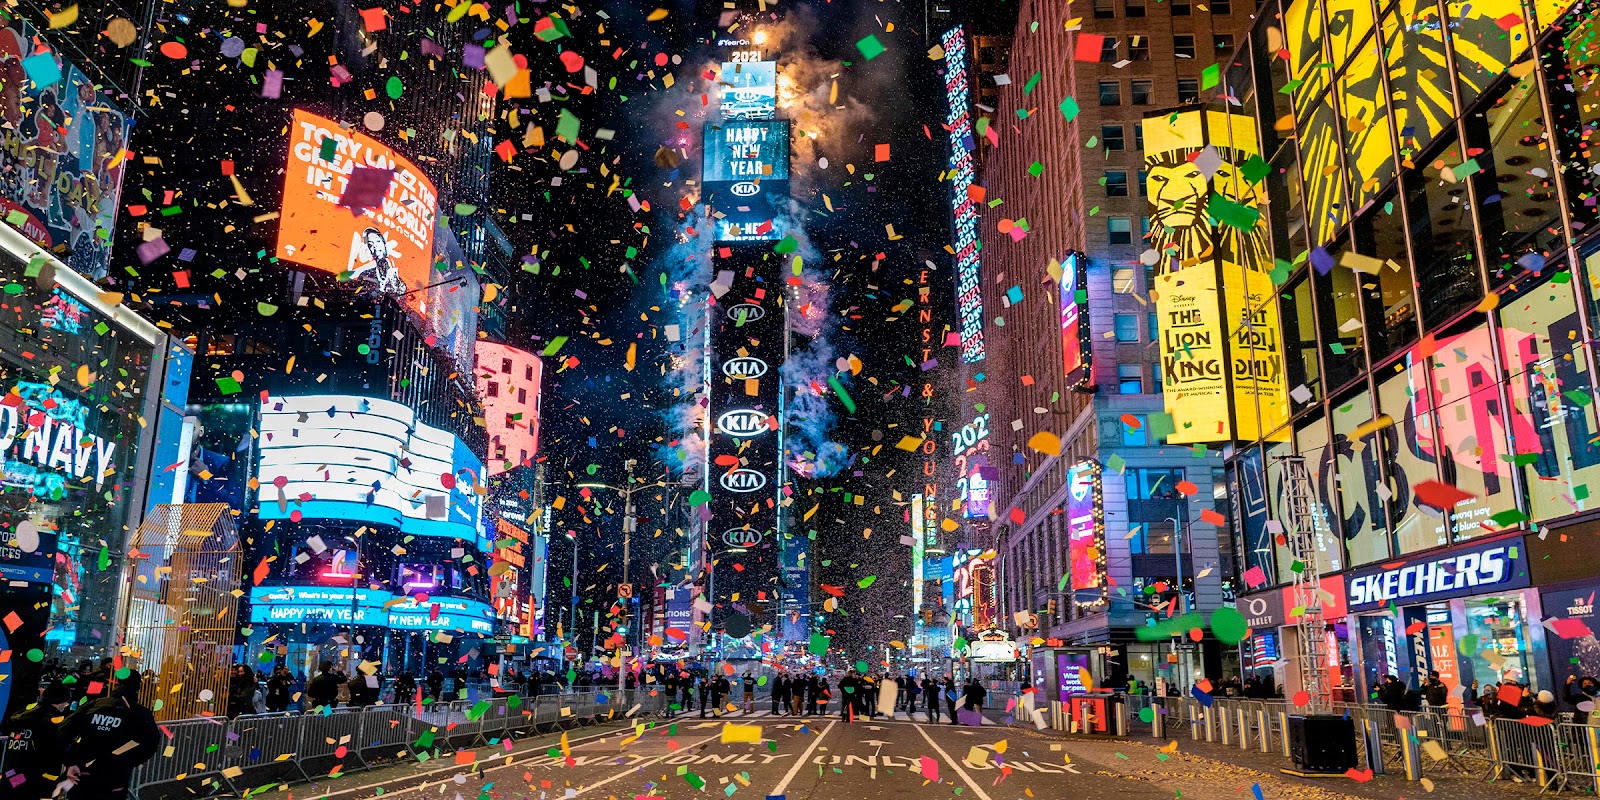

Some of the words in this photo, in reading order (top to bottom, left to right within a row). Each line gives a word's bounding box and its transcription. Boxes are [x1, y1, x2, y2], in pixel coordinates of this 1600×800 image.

[732, 51, 761, 62] 2021
[945, 60, 965, 84] 2021
[946, 69, 967, 92] 2021
[947, 102, 968, 126] 2021
[726, 128, 768, 143] HAPPY
[733, 144, 760, 159] NEW
[4, 129, 100, 214] HOLIDAY
[307, 166, 332, 190] IN
[730, 160, 763, 175] YEAR
[22, 222, 46, 242] AVY
[955, 230, 976, 253] 2021
[957, 239, 977, 262] 2021
[958, 274, 979, 297] 2021
[959, 284, 980, 306] 2021
[1169, 294, 1195, 303] Disney
[920, 270, 931, 362] ERNST
[961, 320, 982, 342] 2021
[962, 330, 984, 352] 2021
[1165, 330, 1211, 353] LION
[730, 362, 760, 374] KIA
[1164, 356, 1220, 386] KING
[922, 383, 933, 398] &
[726, 415, 761, 430] KIA
[24, 410, 115, 484] NAVY
[923, 418, 936, 520] YOUNG
[728, 474, 758, 487] KIA
[543, 505, 551, 532] Locker
[730, 533, 755, 542] KIA
[1350, 547, 1505, 605] SKECHERS
[271, 608, 304, 618] HAPPY
[307, 608, 334, 619] NEW
[337, 609, 365, 620] YEAR
[1567, 605, 1593, 615] TISSOT
[400, 616, 424, 626] NEW
[424, 616, 450, 626] YEAR
[1247, 616, 1272, 626] OAKLEY
[91, 714, 121, 728] NYPD
[8, 740, 28, 750] DCPI
[665, 753, 793, 765] ONLY
